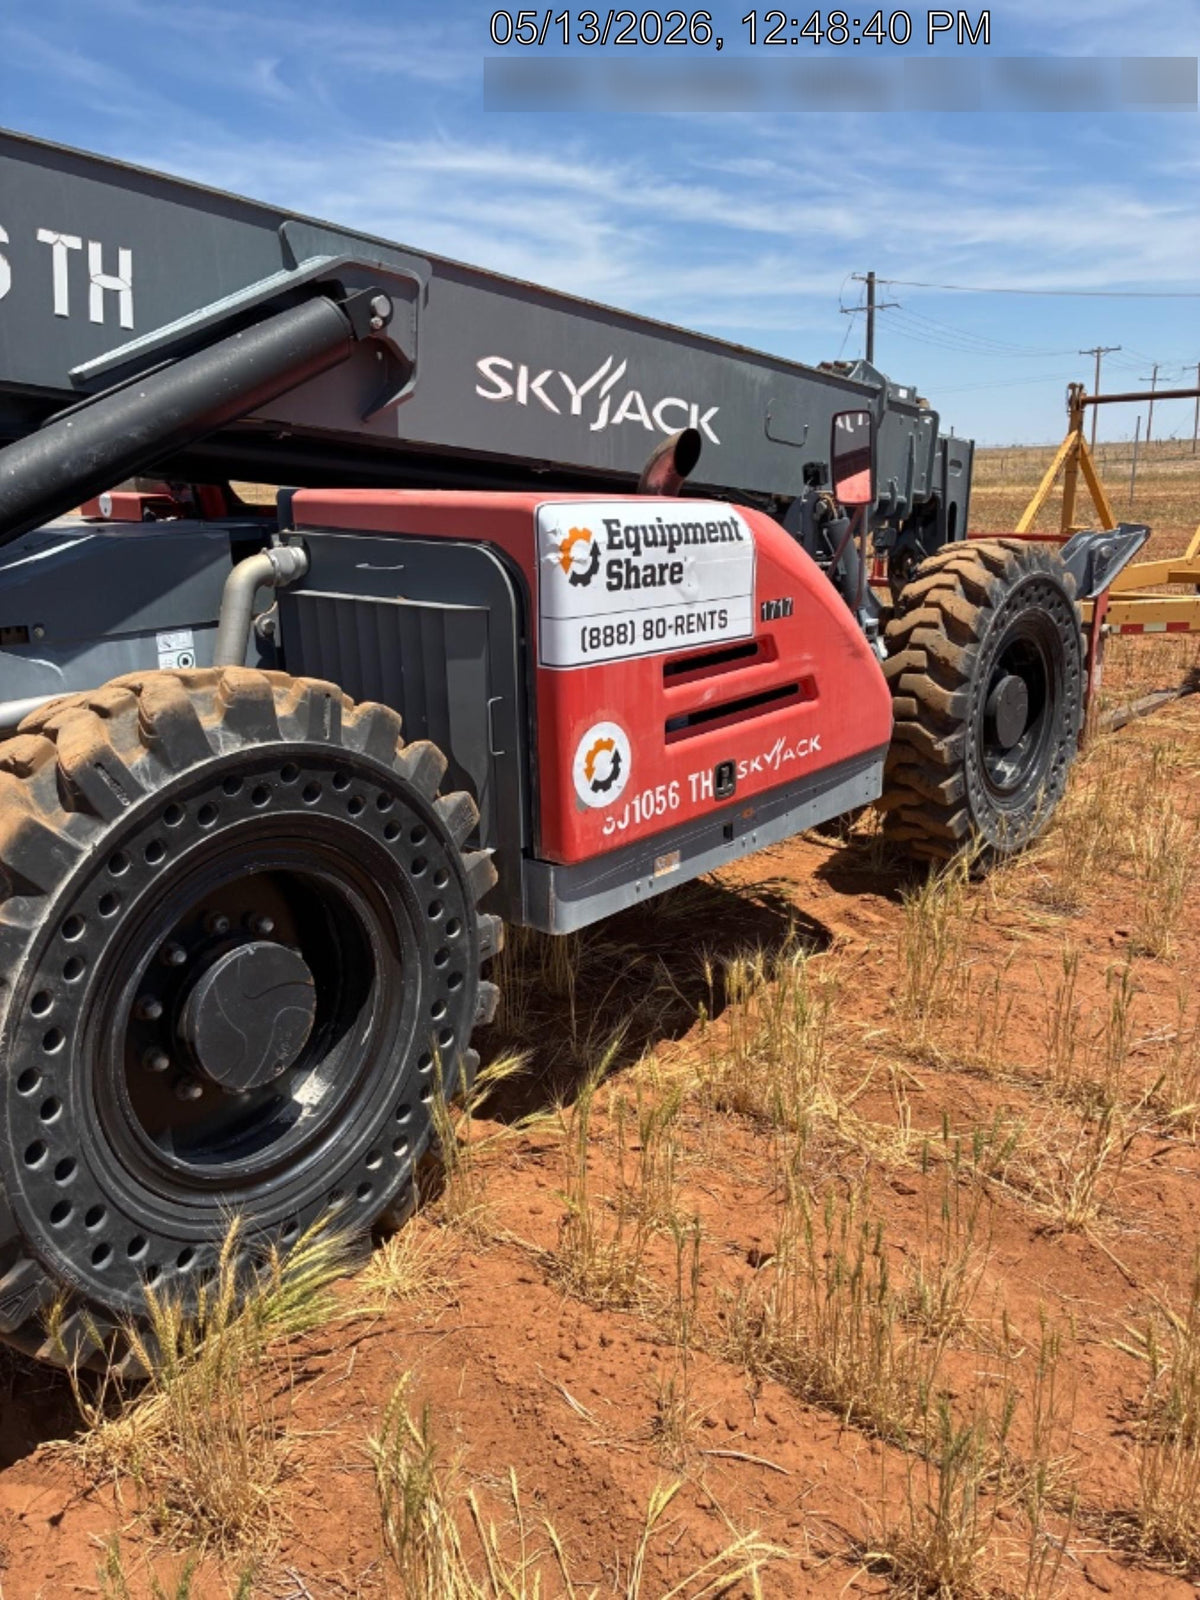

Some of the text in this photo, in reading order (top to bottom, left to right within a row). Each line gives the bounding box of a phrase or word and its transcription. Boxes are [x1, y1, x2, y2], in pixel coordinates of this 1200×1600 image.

[36, 227, 134, 330] TH
[475, 355, 721, 445] SKYJACK
[602, 516, 743, 556] Equipment
[605, 558, 684, 592] Share
[761, 597, 793, 622] 1717
[581, 609, 729, 653] (888) 80-RENTS
[737, 735, 822, 779] SKYJACK
[688, 767, 713, 803] TH
